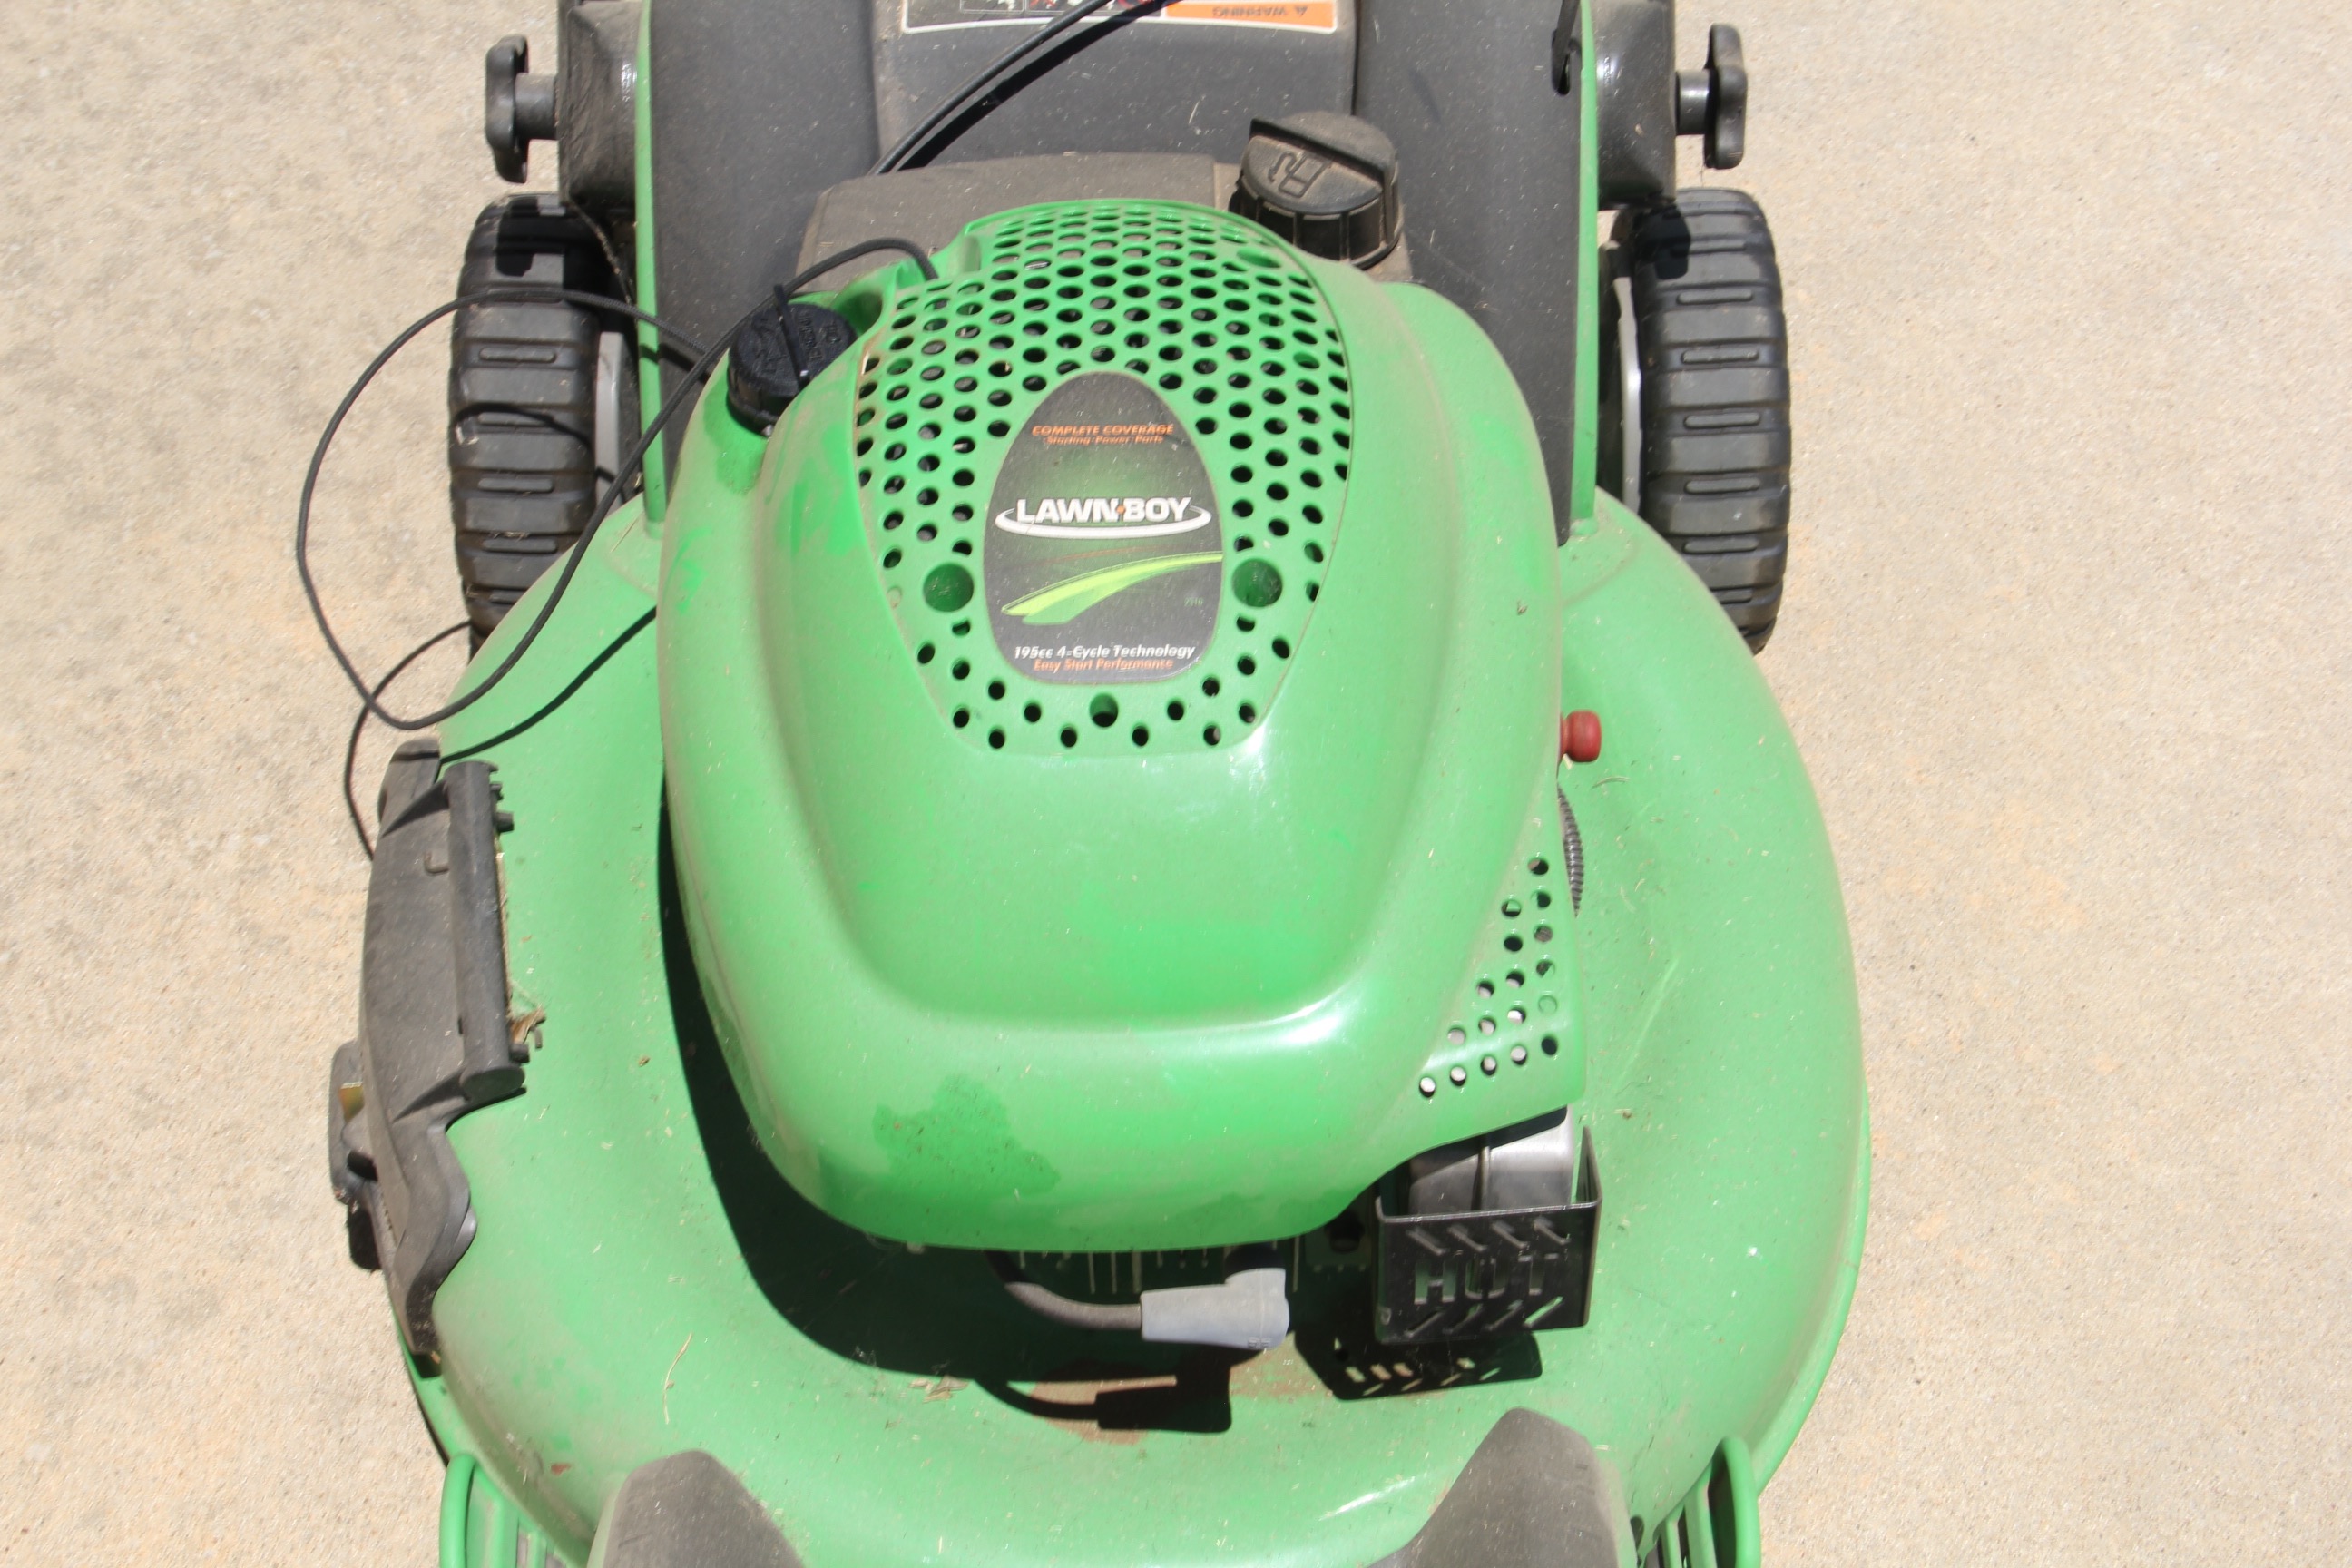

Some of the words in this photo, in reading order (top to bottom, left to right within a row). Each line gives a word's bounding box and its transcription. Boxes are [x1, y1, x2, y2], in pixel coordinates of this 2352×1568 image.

[1212, 5, 1286, 17] WARNING
[1032, 425, 1100, 436] COMPLETE
[1102, 424, 1174, 436] COVERAGE
[1094, 435, 1131, 444] Power
[1134, 435, 1164, 443] Parts
[1014, 646, 1054, 659] 195cc
[1056, 645, 1111, 660] 4-Cycle
[1113, 644, 1196, 659] Technology
[1034, 660, 1061, 673] Easy
[1063, 659, 1093, 671] Start
[1095, 657, 1174, 671] Performance
